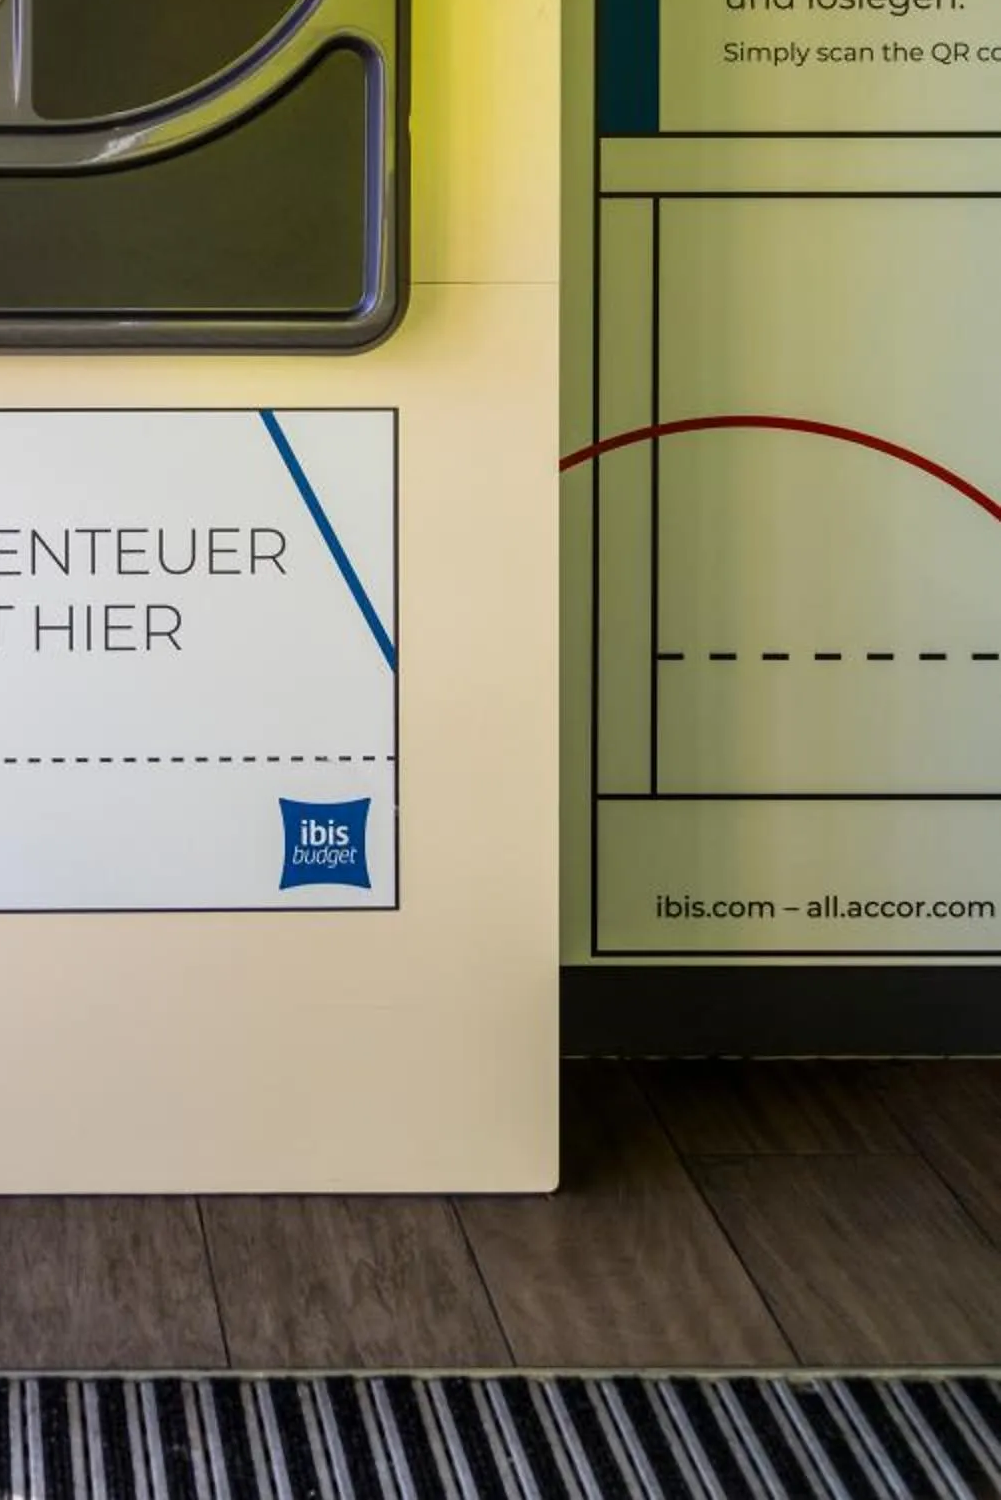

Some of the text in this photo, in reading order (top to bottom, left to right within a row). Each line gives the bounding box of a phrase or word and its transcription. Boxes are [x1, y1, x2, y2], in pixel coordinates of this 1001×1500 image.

[723, 41, 811, 67] Simply
[816, 46, 874, 63] scan
[881, 41, 924, 62] the
[930, 42, 970, 65] QR
[35, 604, 182, 652] HIER
[301, 819, 349, 846] ibis
[292, 845, 357, 869] budget
[656, 894, 775, 919] ibis.com
[806, 895, 995, 919] all.accor.com
